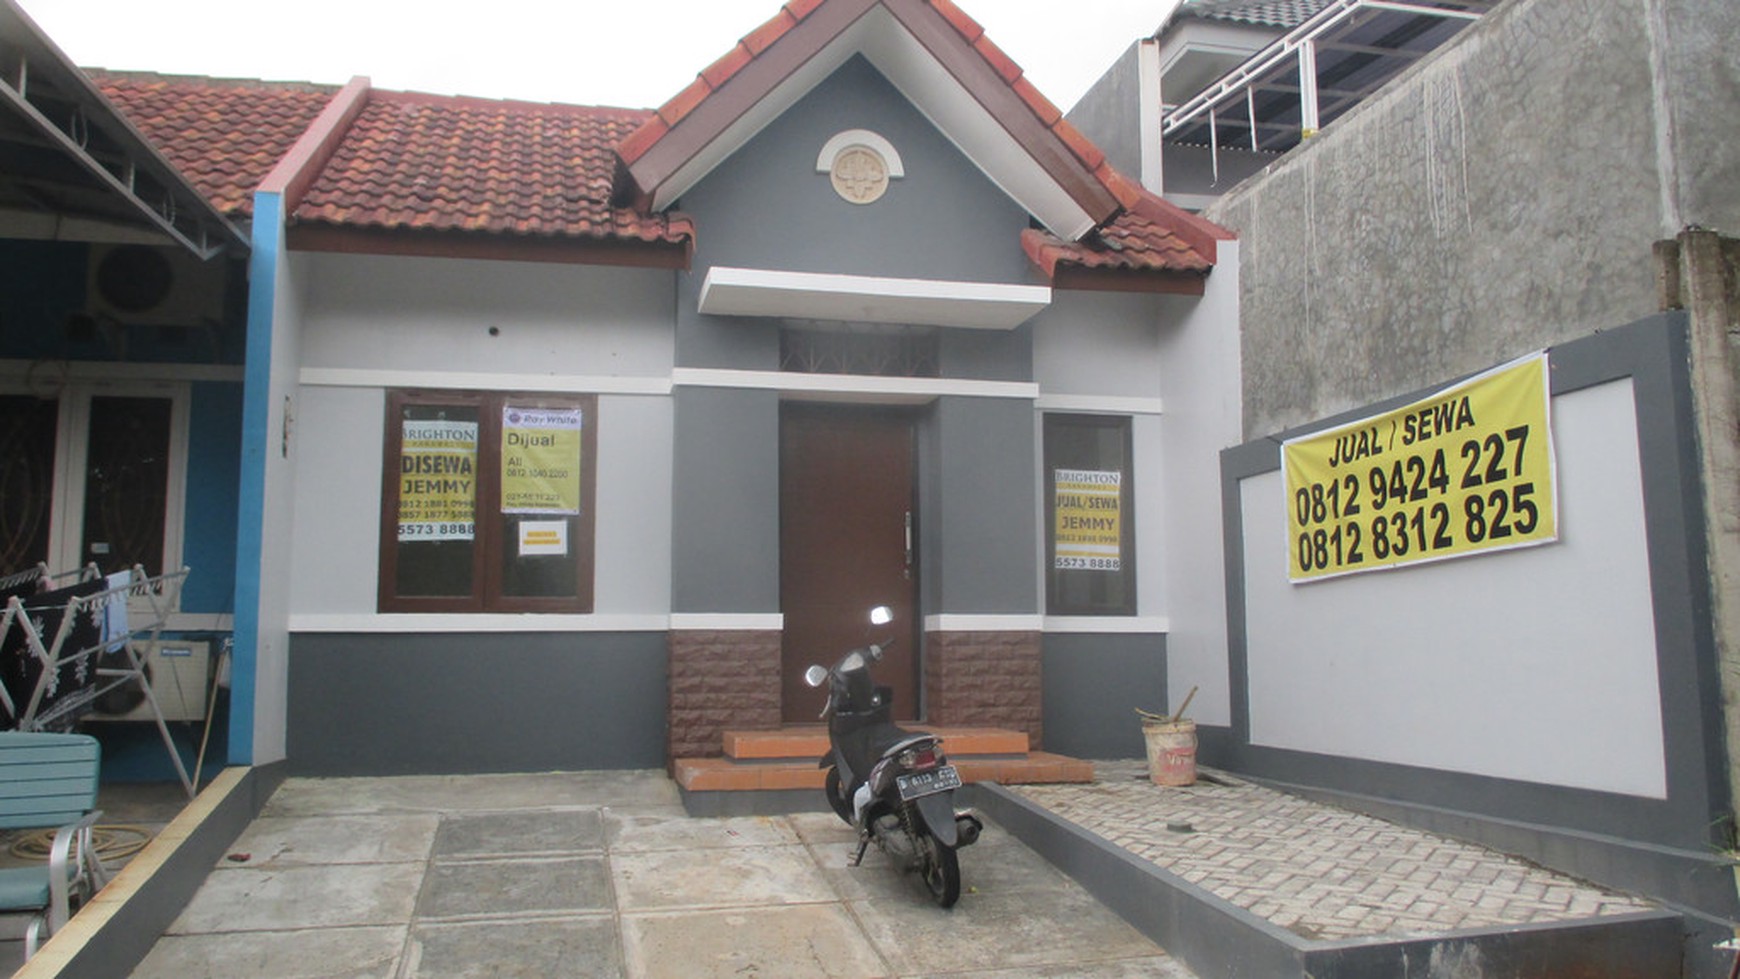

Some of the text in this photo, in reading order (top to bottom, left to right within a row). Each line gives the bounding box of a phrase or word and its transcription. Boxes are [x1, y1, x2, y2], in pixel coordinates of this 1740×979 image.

[547, 414, 577, 424] White
[1329, 427, 1383, 467] JUAL
[1402, 396, 1475, 445] SEWA
[507, 433, 555, 448] Dijual
[402, 455, 472, 474] DISEWA
[1056, 472, 1119, 484] BRIGHTON
[1296, 424, 1529, 527] 0812 9424 227
[403, 480, 471, 494] JEMMY
[1056, 495, 1119, 510] JUAL/SEWA
[398, 524, 476, 535] 5573 8888
[1062, 516, 1115, 530] JEMMY
[1298, 482, 1538, 572] 0812 8312 825
[1056, 557, 1120, 569] 5573 8888
